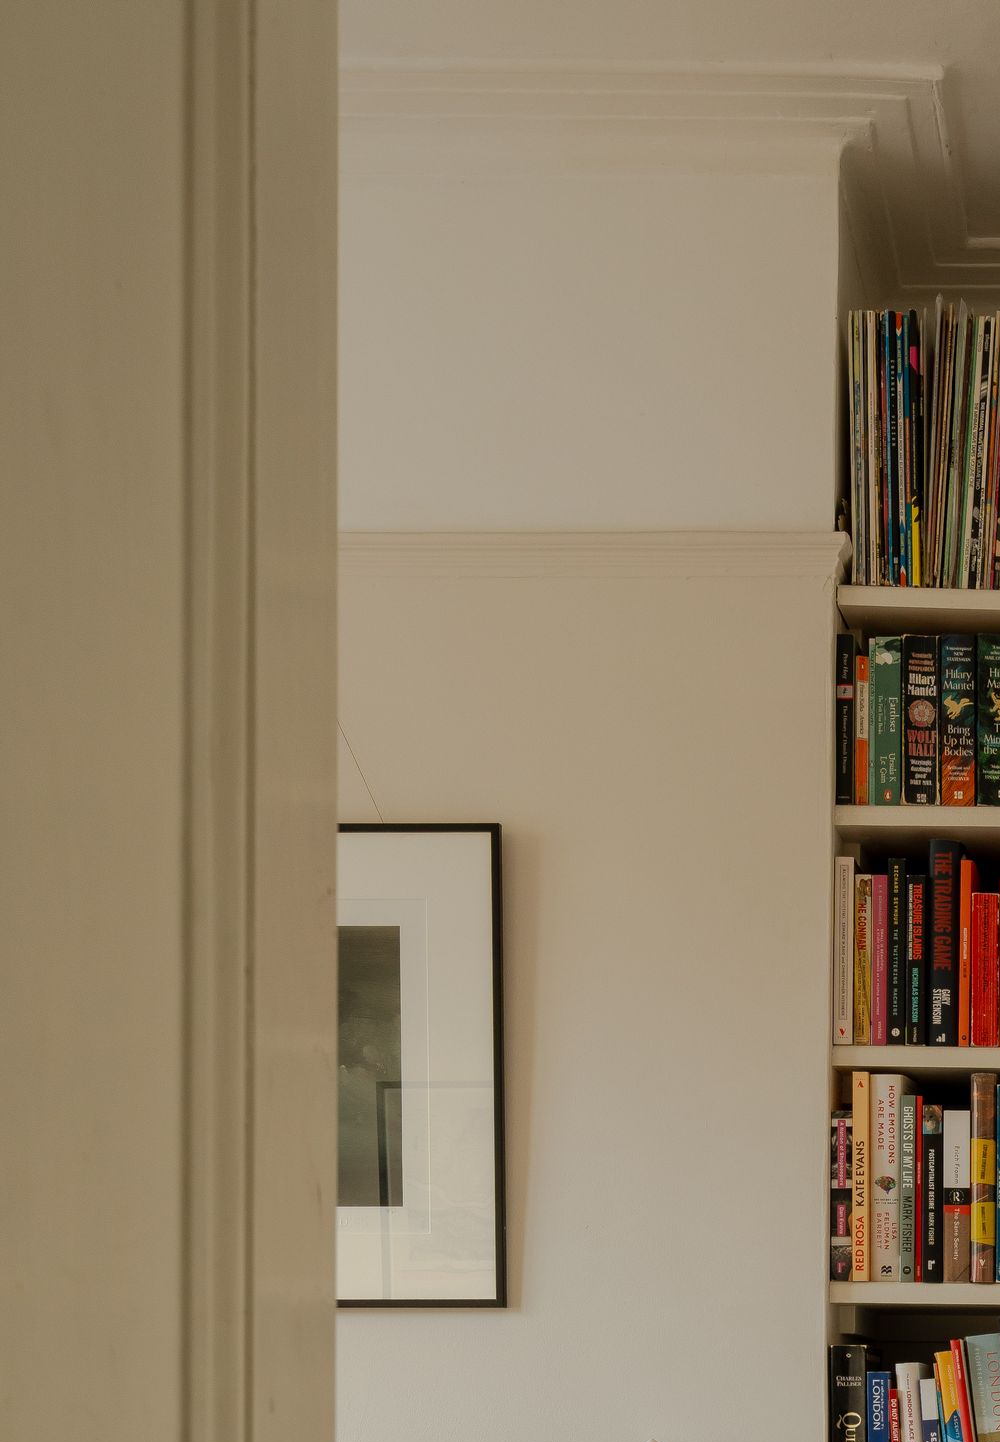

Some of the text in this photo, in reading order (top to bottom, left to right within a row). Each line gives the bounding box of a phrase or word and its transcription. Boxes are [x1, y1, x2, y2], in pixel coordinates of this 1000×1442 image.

[909, 673, 935, 686] Hilary
[943, 681, 974, 690] Mantel
[946, 669, 972, 681] Hilary
[908, 685, 936, 696] Mantel
[889, 697, 899, 732] Earthsea
[944, 736, 974, 745] Up the
[948, 725, 970, 736] Bring
[908, 743, 935, 756] HALL
[945, 746, 974, 756] Bodies
[913, 884, 923, 960] TREASURE ISLANDS
[934, 852, 952, 971] THE TRADING GAME
[857, 916, 867, 952] CONMAN
[932, 989, 942, 1025] STEVENSON
[941, 989, 951, 1005] GARY
[856, 1141, 864, 1207] KATE EVANS
[902, 1196, 912, 1252] MARK FISHER
[856, 1216, 864, 1271] RED ROSA
[872, 1379, 881, 1430] LONDON
